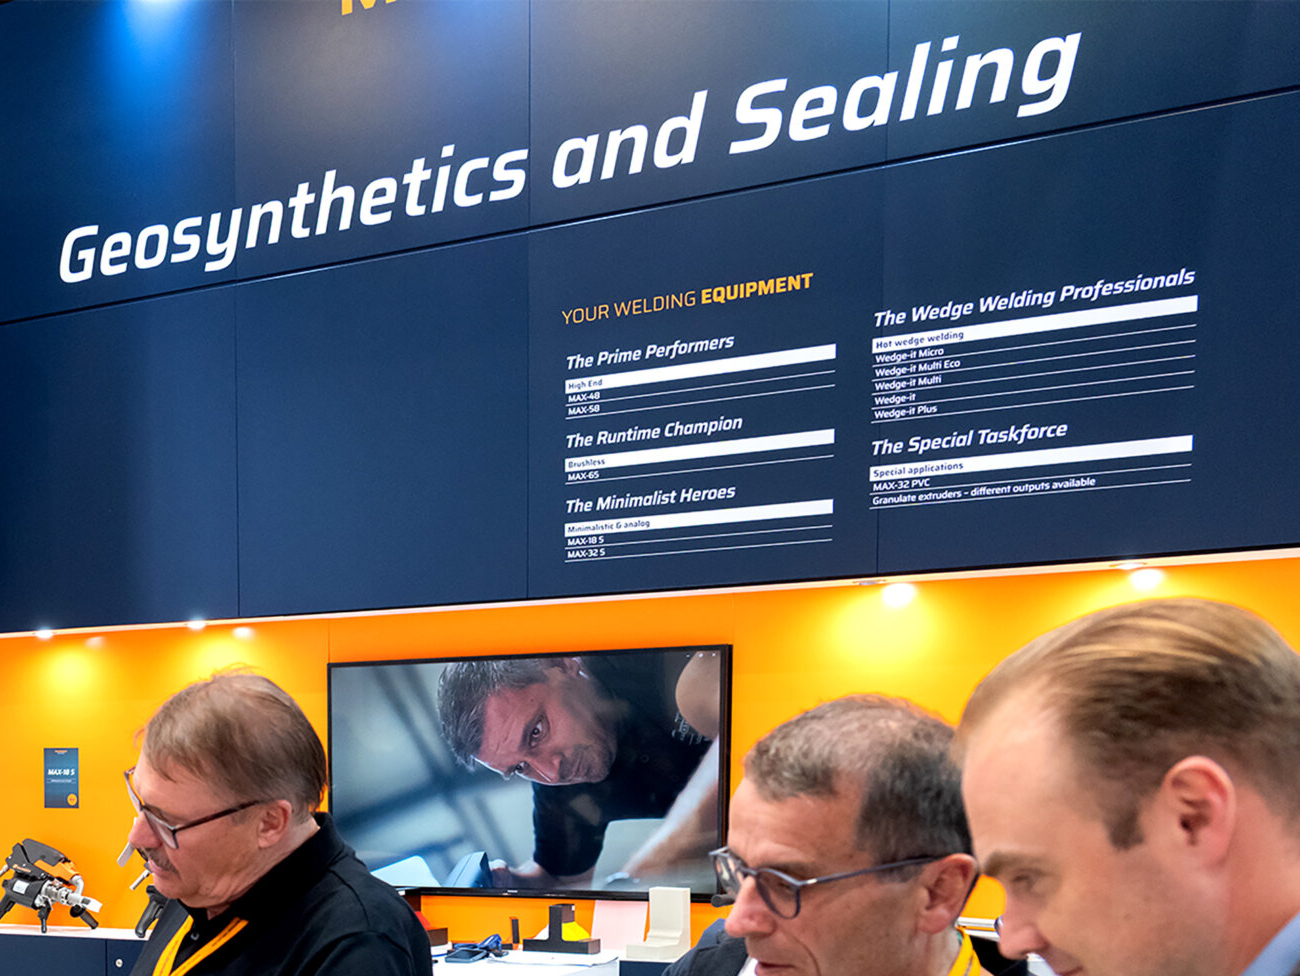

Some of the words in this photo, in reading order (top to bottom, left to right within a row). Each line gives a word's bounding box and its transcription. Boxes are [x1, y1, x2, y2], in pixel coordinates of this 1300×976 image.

[58, 142, 527, 283] Geosynthetics
[551, 90, 707, 193] and
[729, 30, 1082, 157] Sealing
[561, 304, 609, 324] YOUR
[614, 291, 696, 317] WELDING
[700, 273, 814, 304] EQUIPMENT
[874, 310, 906, 327] The
[911, 301, 974, 321] Wedge
[979, 289, 1056, 313] Welding
[1059, 267, 1196, 302] Professionals
[876, 340, 893, 349] Hot
[894, 336, 925, 348] wedge
[927, 330, 964, 344] welding
[566, 355, 594, 370] The
[597, 348, 641, 366] Prime
[645, 336, 735, 360] Performers
[875, 351, 917, 364] Wedge-it
[918, 346, 944, 358] Micro
[875, 364, 917, 378] Wedge-it
[918, 361, 942, 372] Multi
[944, 359, 961, 369] Eco
[568, 381, 587, 391] High
[588, 379, 603, 389] End
[875, 379, 916, 392] Wedge-it
[918, 375, 942, 386] Multi
[568, 392, 600, 403] MAX-48
[874, 393, 916, 405] Wedge-it
[568, 404, 600, 415] MAX-58
[874, 408, 916, 420] Wedge-it
[917, 404, 938, 415] Plus
[566, 434, 593, 449] The
[596, 426, 660, 445] Runtime
[663, 416, 743, 438] Champion
[871, 440, 904, 456] The
[907, 430, 973, 454] Special
[978, 423, 1068, 445] Taskforce
[568, 458, 605, 468] Brushless
[873, 467, 906, 478] Special
[908, 462, 964, 475] applications
[568, 471, 600, 481] MAX-65
[873, 480, 910, 491] MAX-32
[911, 478, 930, 488] PVC
[873, 494, 917, 506] Granulate
[918, 490, 962, 501] extruders
[970, 483, 1011, 497] different
[1013, 481, 1050, 493] outputs
[1052, 476, 1096, 489] available
[565, 500, 592, 513] The
[595, 490, 676, 511] Minimalist
[679, 486, 736, 503] Heroes
[568, 523, 614, 533] Minimalistic
[623, 520, 650, 529] analog
[567, 537, 598, 546] MAX-18
[598, 536, 604, 544] S
[567, 549, 599, 559] MAX-32
[599, 548, 605, 557] S
